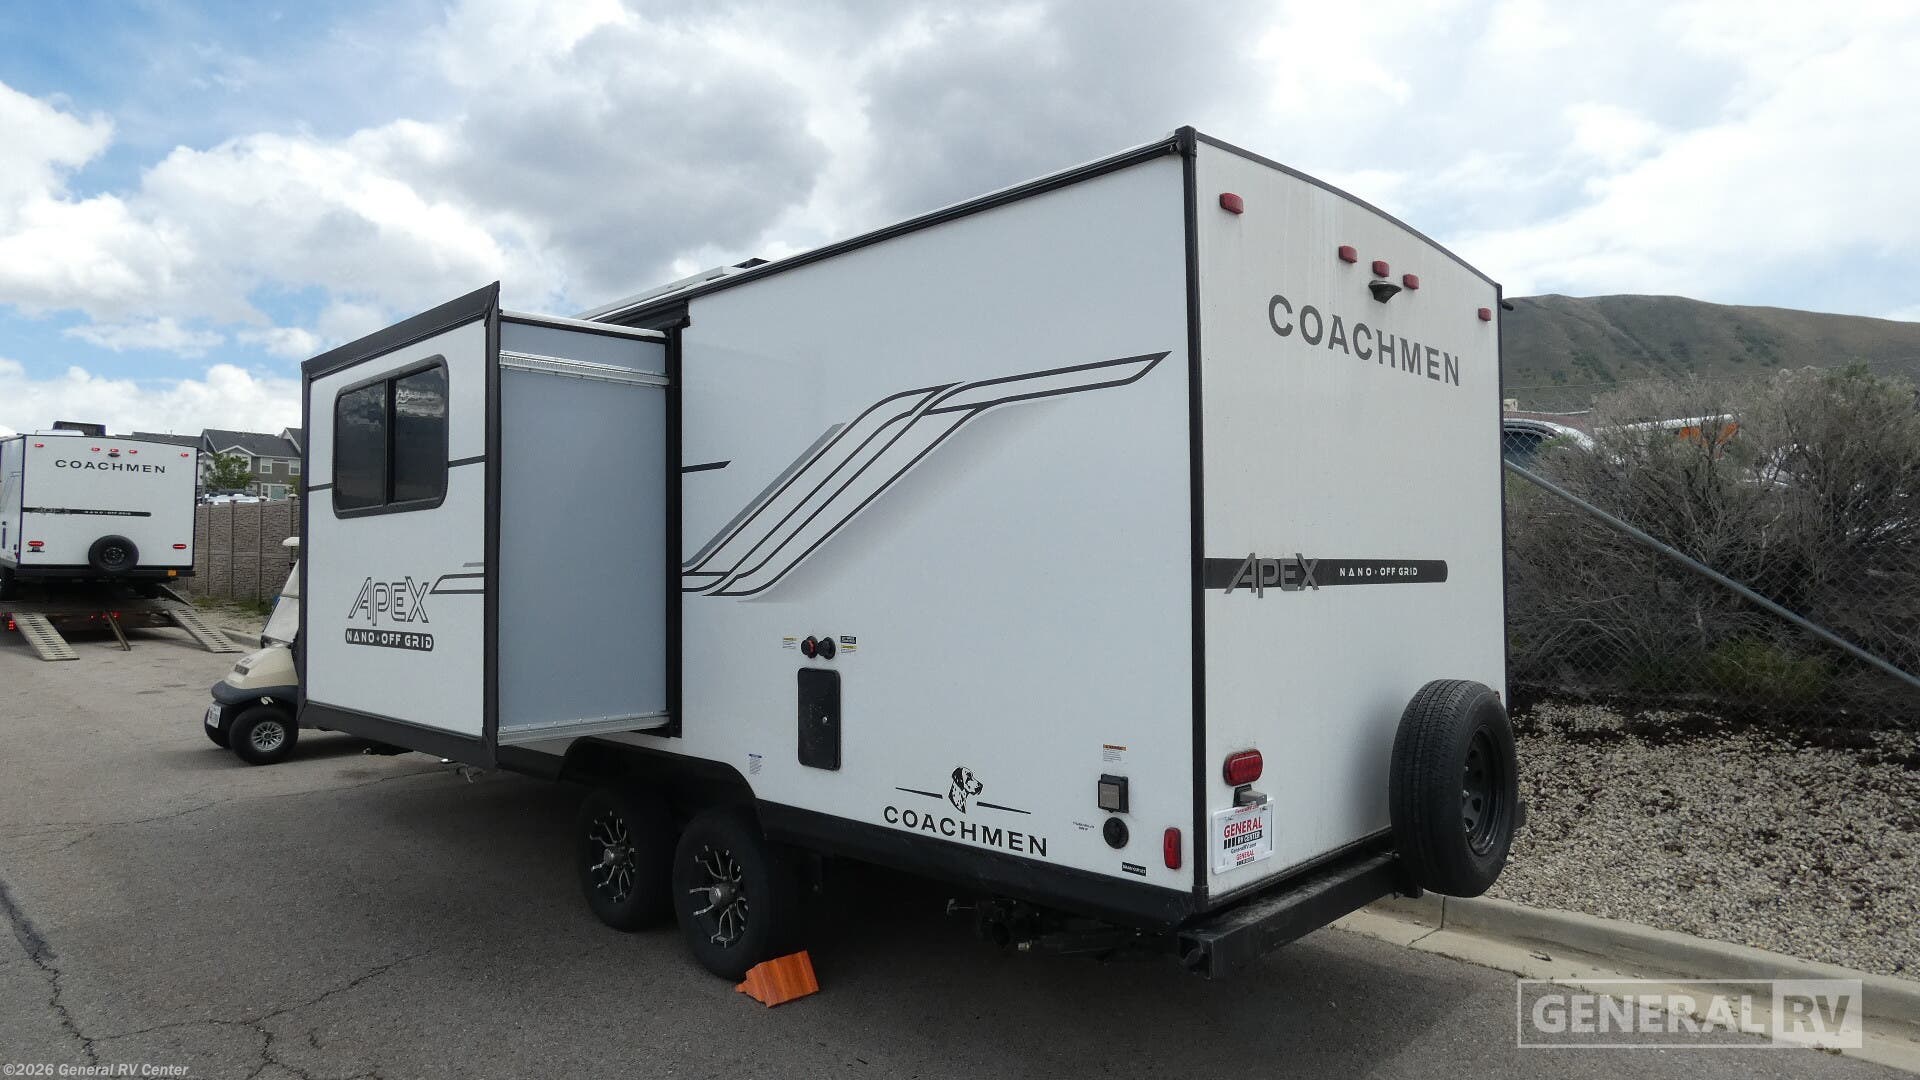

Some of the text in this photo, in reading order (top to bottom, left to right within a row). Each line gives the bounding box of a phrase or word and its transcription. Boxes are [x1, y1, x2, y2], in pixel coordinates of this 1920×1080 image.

[1268, 294, 1460, 387] COACHMEN
[55, 459, 166, 473] COACHMEN
[1224, 552, 1320, 599] APEX
[1380, 567, 1396, 576] OFF
[1398, 567, 1418, 576] GRID
[348, 575, 430, 627] APEX
[381, 632, 401, 646] OFF
[404, 634, 432, 649] GRID
[883, 805, 1047, 857] COACHMEN
[1223, 816, 1263, 838] GENERAL
